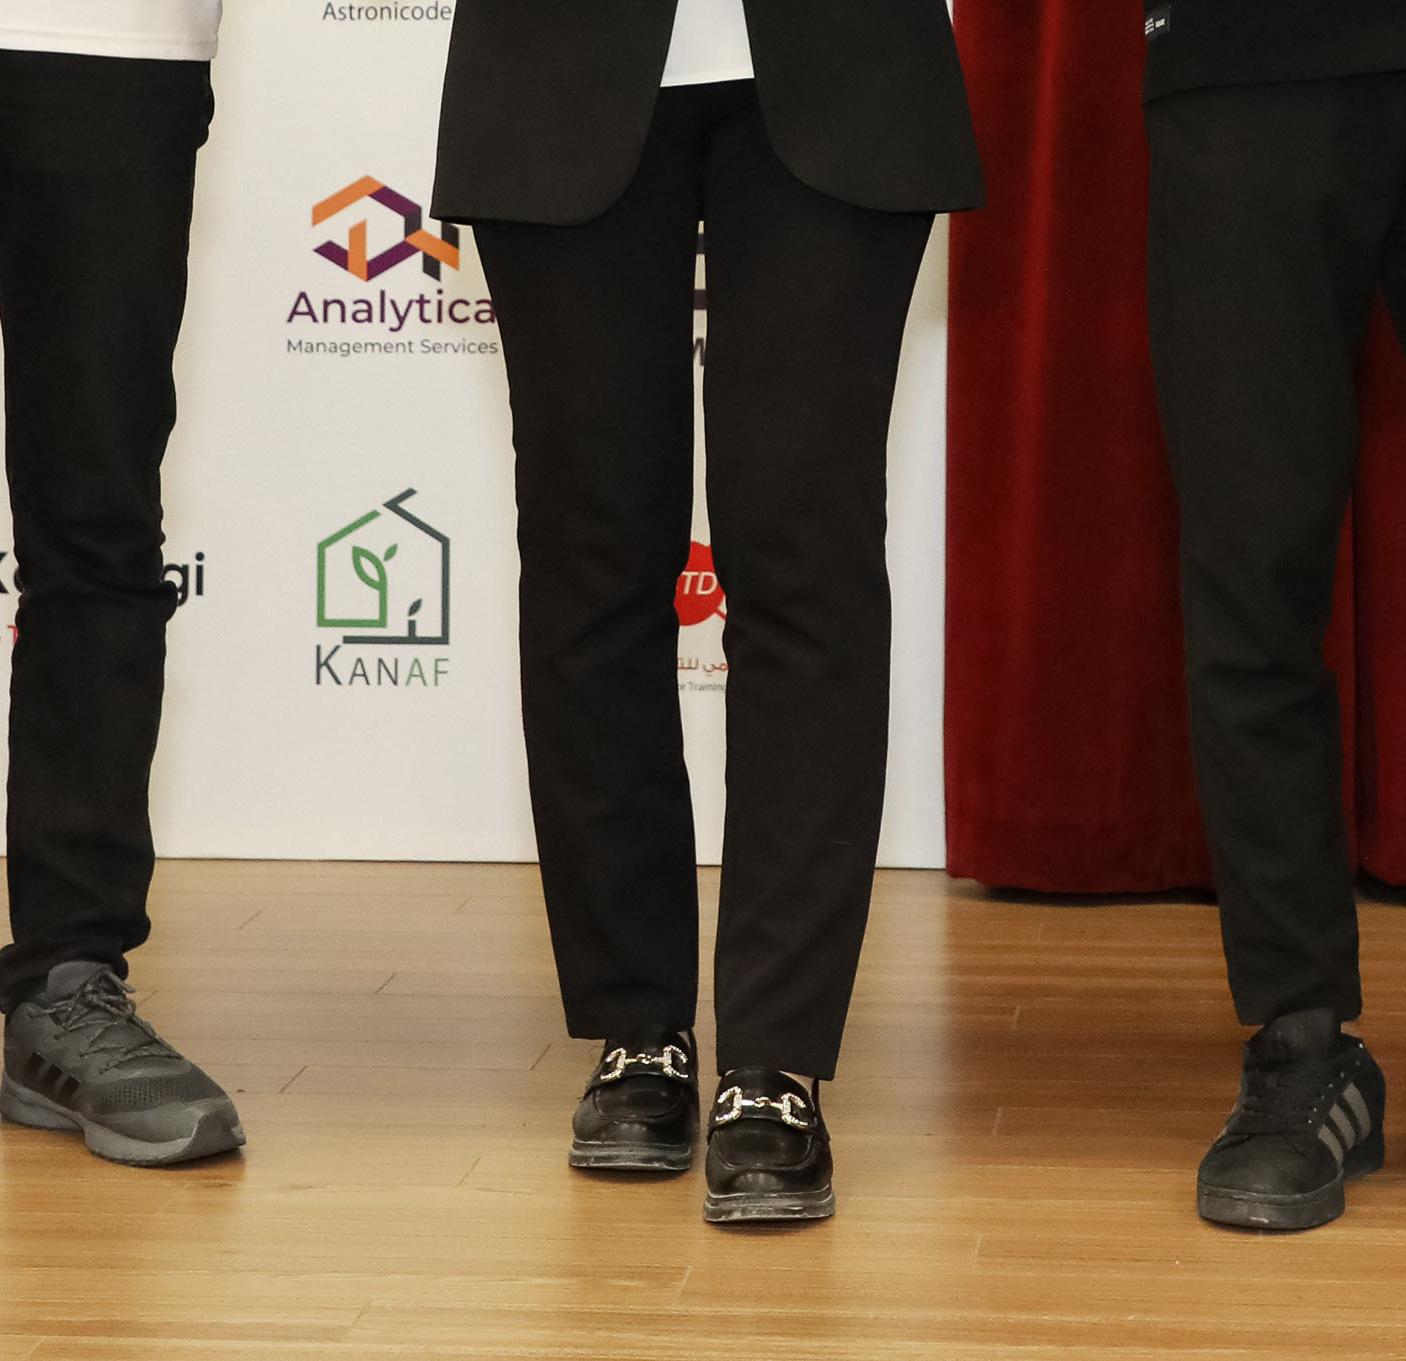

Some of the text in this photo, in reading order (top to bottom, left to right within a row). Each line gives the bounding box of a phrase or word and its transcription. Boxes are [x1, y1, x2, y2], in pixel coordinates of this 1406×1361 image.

[323, 1, 452, 21] Astronicode
[287, 289, 497, 332] Analytica
[287, 337, 498, 357] Management Services
[315, 644, 450, 687] KANAF
